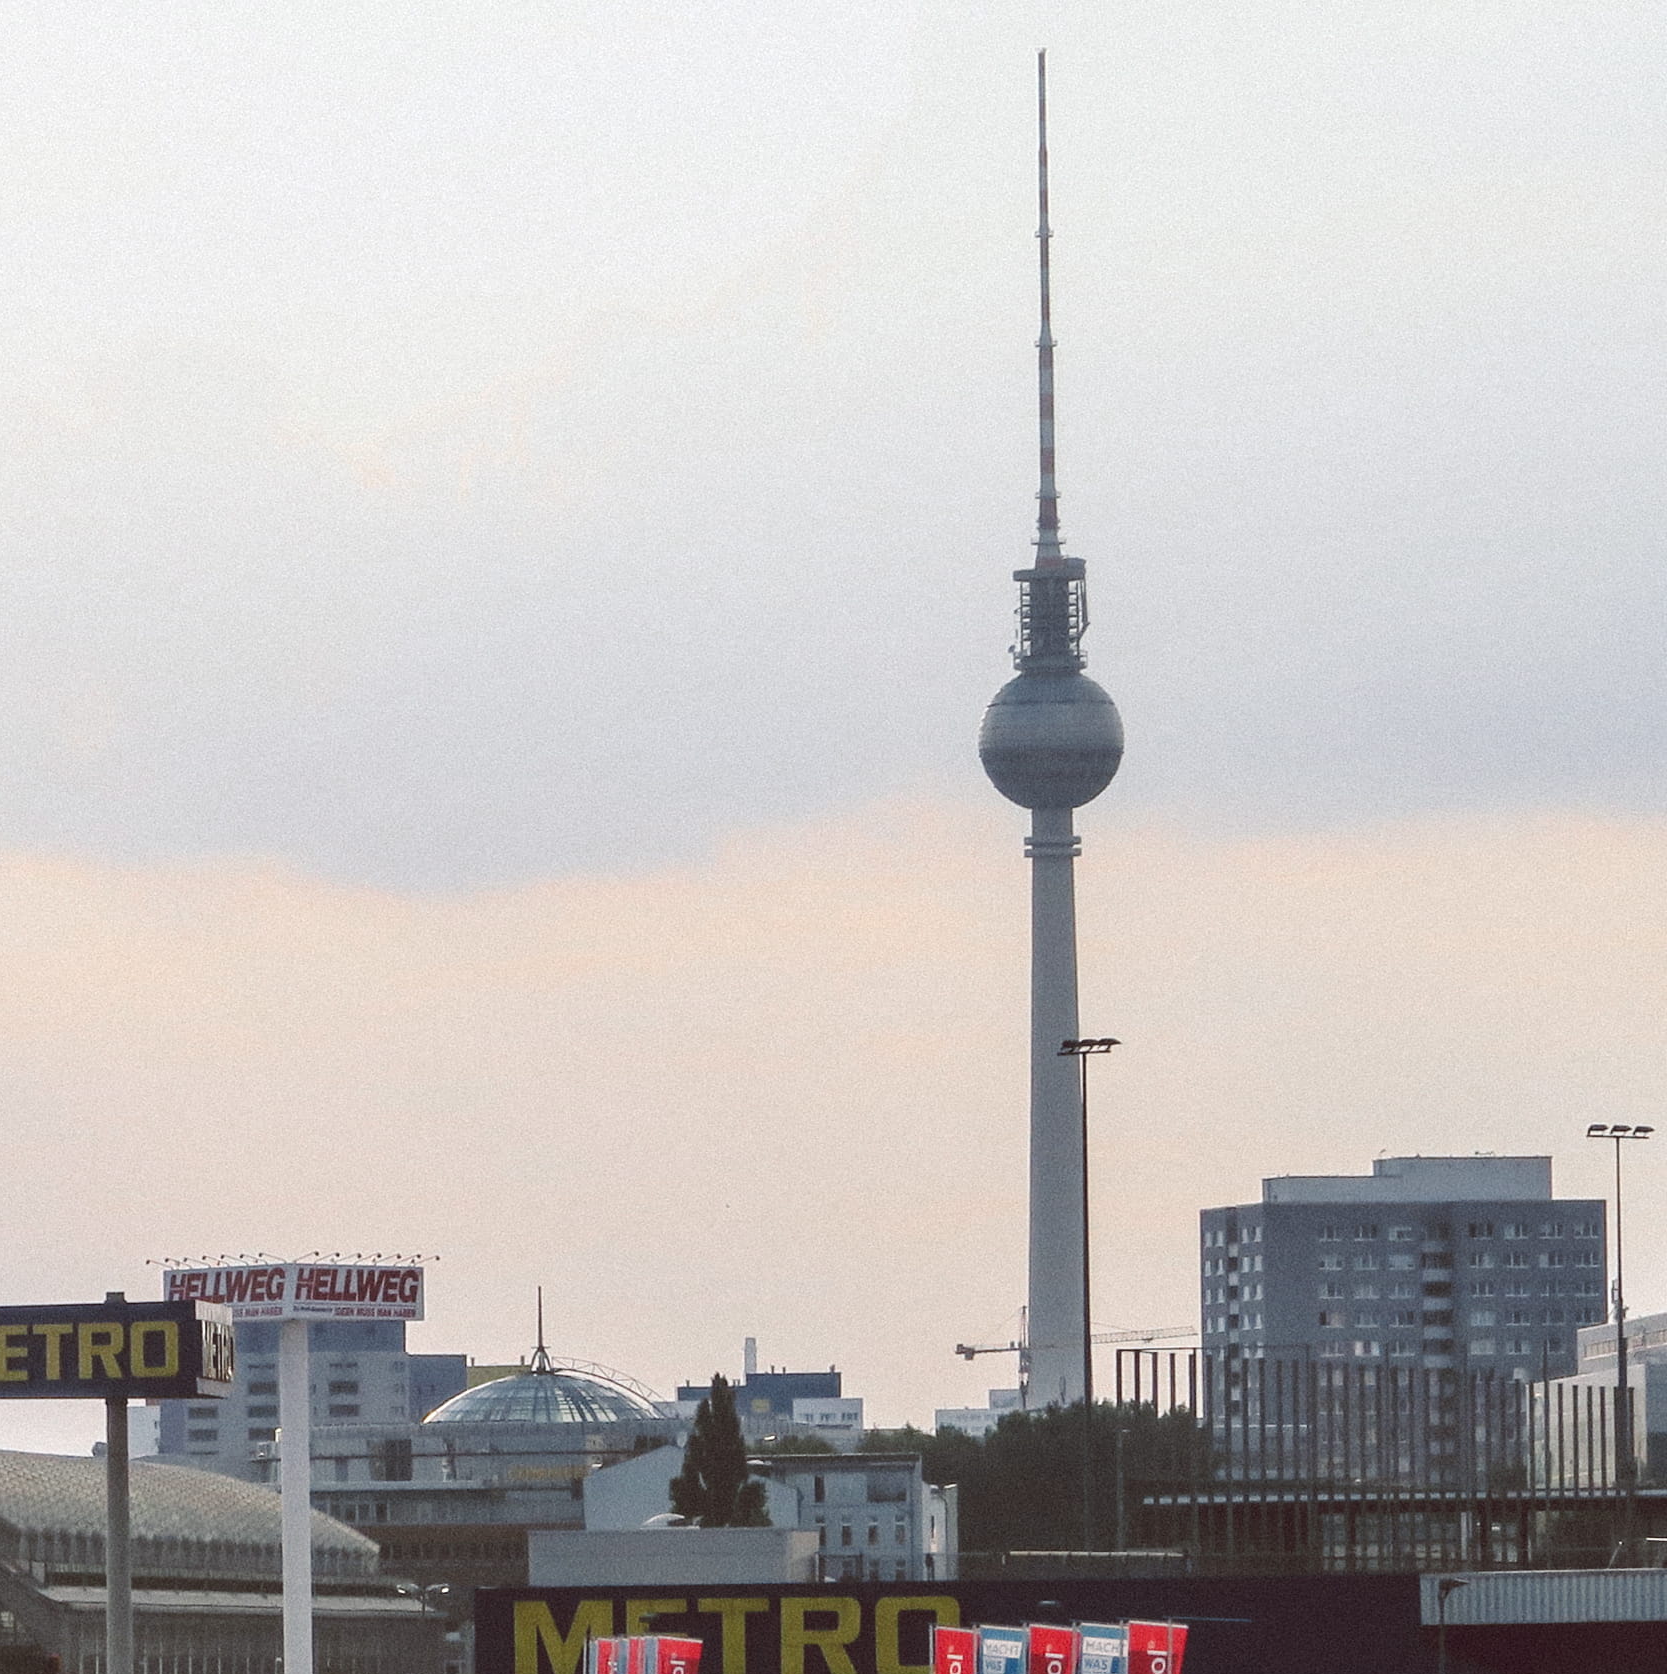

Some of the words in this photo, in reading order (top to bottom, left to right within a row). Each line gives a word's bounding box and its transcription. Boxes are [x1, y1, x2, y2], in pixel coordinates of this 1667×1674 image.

[169, 1268, 285, 1303] HELLWEG
[294, 1267, 419, 1304] HELLWEG
[1083, 1659, 1107, 1671] WAS
